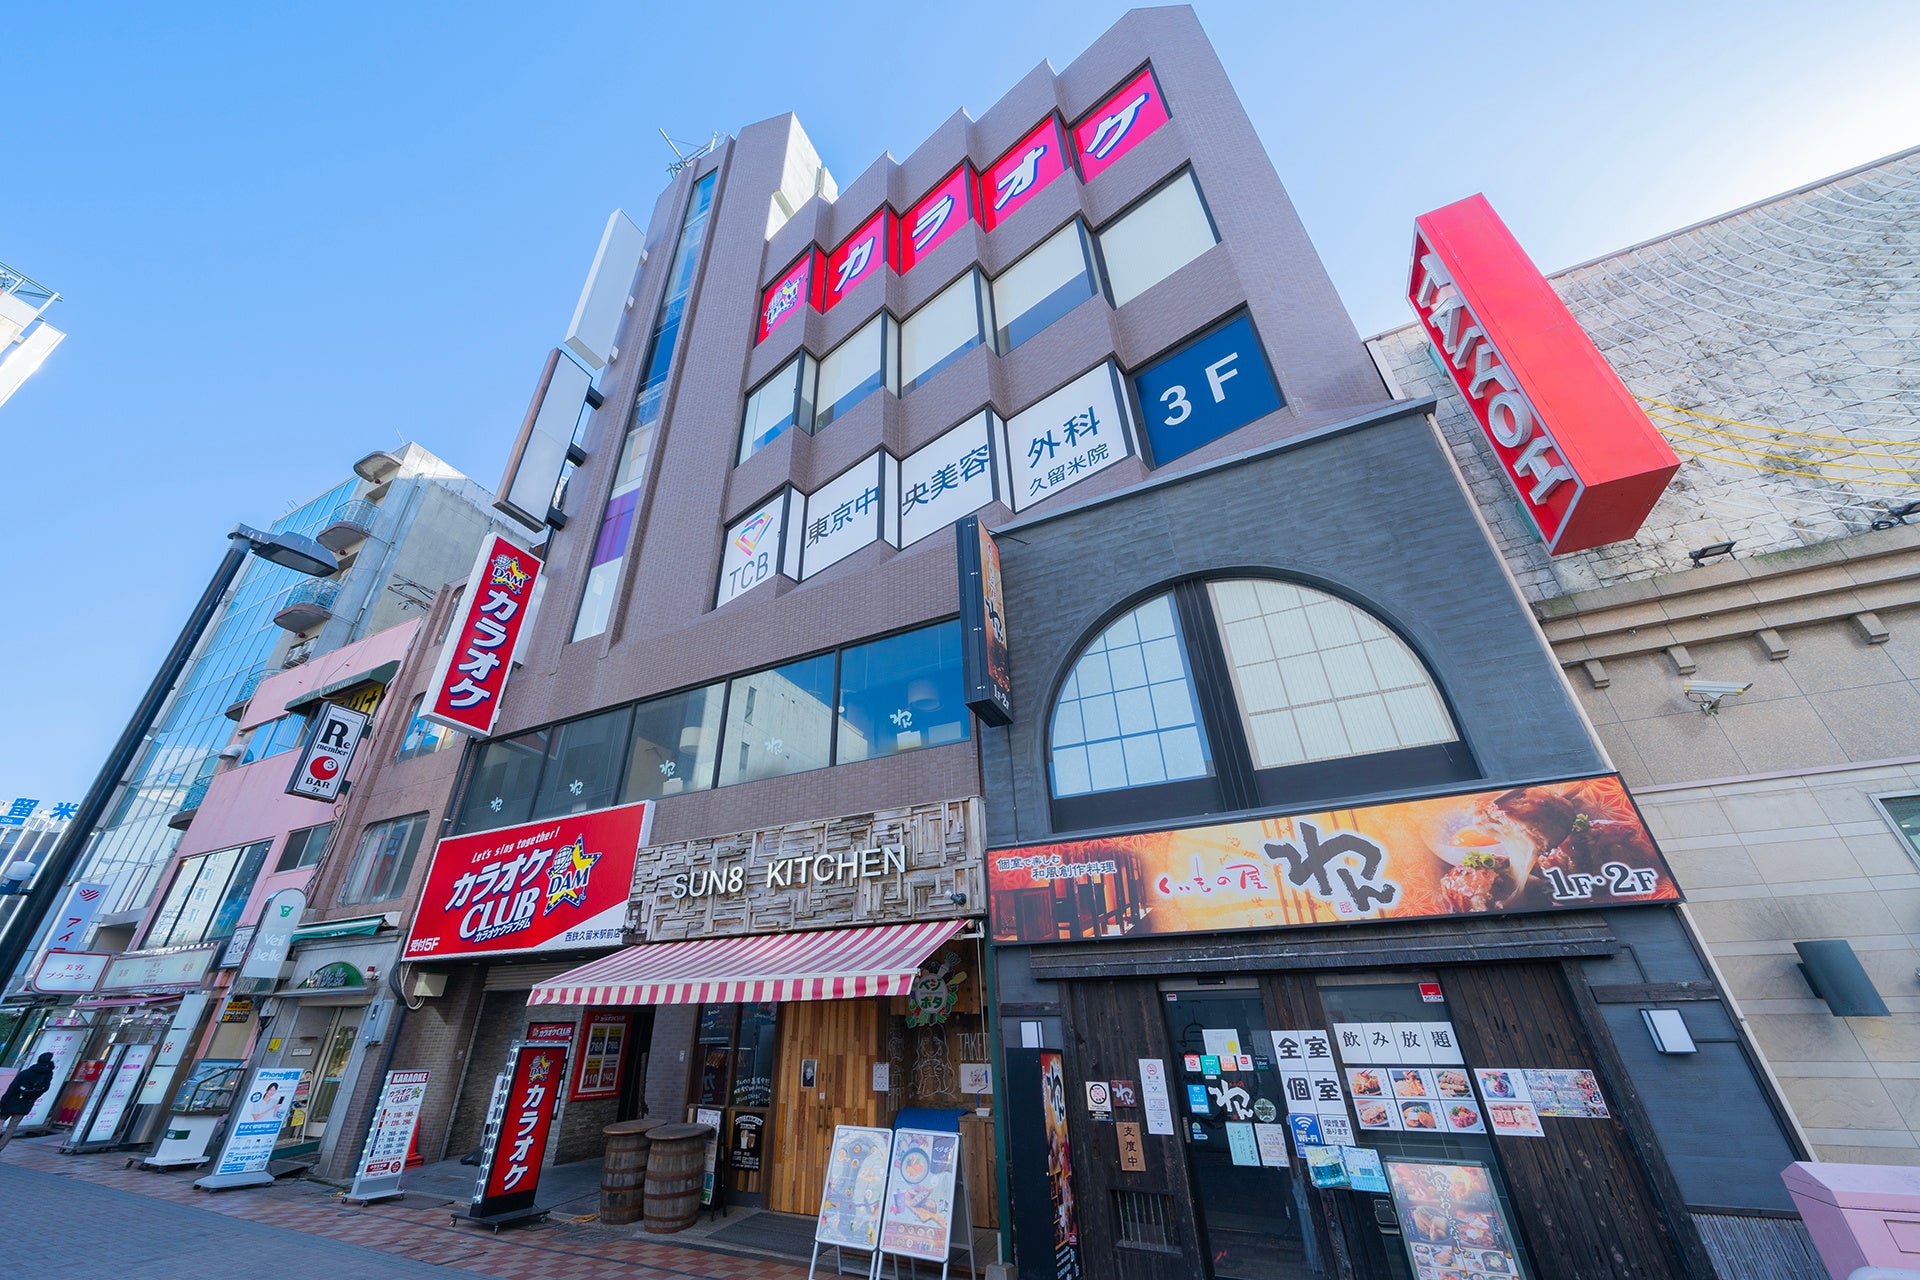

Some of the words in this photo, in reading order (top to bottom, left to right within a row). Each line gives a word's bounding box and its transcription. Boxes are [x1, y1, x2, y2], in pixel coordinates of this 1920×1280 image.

[1159, 351, 1239, 426] 3F
[1416, 252, 1573, 506] TAIYOH
[1029, 443, 1110, 496] 久留米院
[493, 567, 524, 588] DAM
[729, 551, 769, 597] TCB
[449, 588, 520, 709] カラオケ
[320, 718, 351, 750] Re
[316, 743, 349, 757] member
[327, 760, 335, 769] 3
[305, 777, 331, 789] BAR
[471, 849, 492, 864] Let's
[494, 843, 514, 857] sing
[516, 826, 561, 850] together!
[671, 866, 744, 900] SUN8
[766, 844, 907, 889] KITCHEN
[997, 855, 1061, 871] 個室で楽しむ
[1032, 861, 1117, 880] 和風創作料理
[1264, 821, 1396, 912] わん
[446, 848, 553, 911] カラオケ
[548, 867, 590, 897] DAM
[460, 888, 540, 940] CLUB
[54, 917, 82, 950] アイ
[264, 933, 287, 947] Veil
[409, 937, 441, 953] 受付5F
[565, 928, 622, 943] 西鉄久留米駅前店
[1278, 1036, 1330, 1059] 全室
[1342, 1030, 1452, 1048] 飲み放題
[392, 1073, 428, 1083] KARAOKE
[1286, 1077, 1342, 1101] 個室
[503, 1084, 546, 1191] カラオケ
[1123, 1126, 1138, 1167] 支度中
[1297, 1134, 1319, 1142] Wi-Fi
